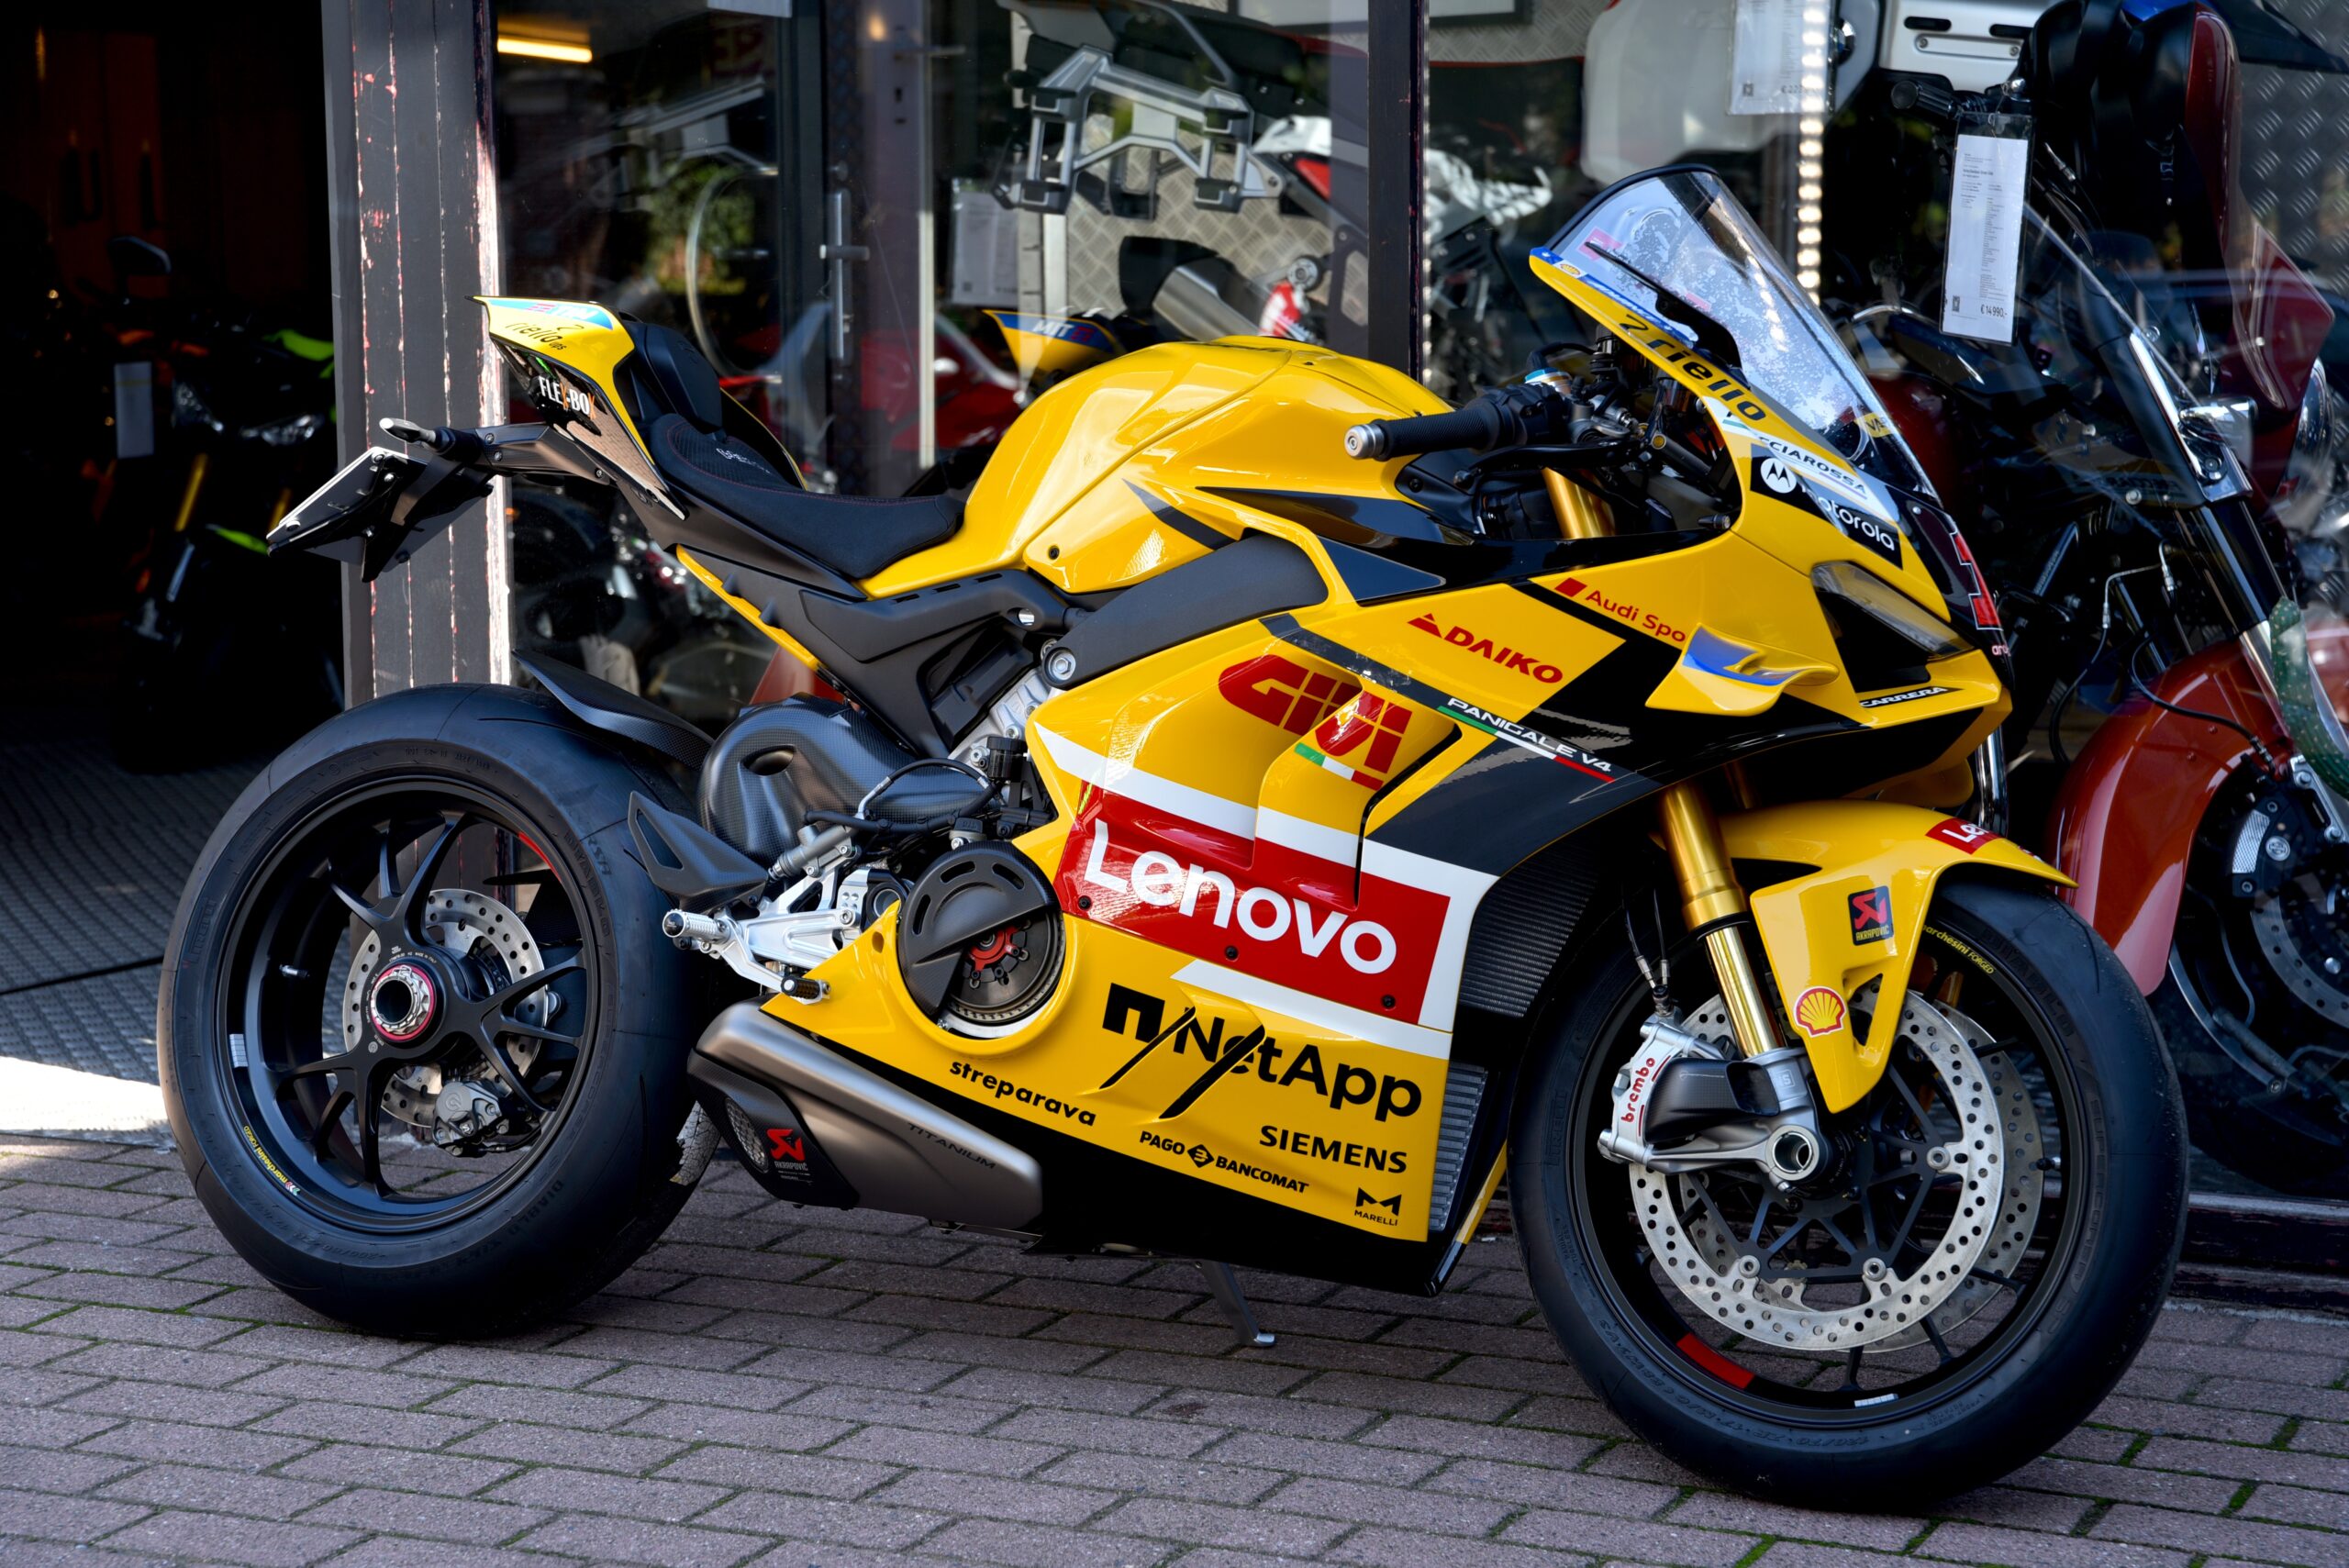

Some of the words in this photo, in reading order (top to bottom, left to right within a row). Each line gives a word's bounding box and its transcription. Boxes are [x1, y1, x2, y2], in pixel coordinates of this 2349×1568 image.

[539, 374, 596, 420] FLEX-BOX
[1647, 339, 1766, 421] riello
[1759, 435, 1867, 495] CIAROSSA
[1586, 590, 1640, 623] Audi
[1643, 614, 1687, 643] Spo
[1442, 625, 1564, 684] DAIKO
[1219, 652, 1414, 774] GIVI
[1859, 685, 1949, 708] CARRERA
[1447, 696, 1577, 758] PANIGALE
[1577, 751, 1613, 774] V4
[1082, 818, 1397, 974] Lenovo
[1967, 949, 1996, 974] FORGED
[949, 1059, 1097, 1128] streparava
[1173, 1006, 1424, 1123] NetApp
[1620, 1057, 1656, 1125] brembo
[254, 1146, 288, 1184] marchesini
[907, 1121, 996, 1170] TITANIUM
[1138, 1129, 1186, 1157] PAGO
[1215, 1154, 1309, 1195] BANCOMAT
[1259, 1124, 1408, 1175] SIEMENS
[1353, 1208, 1398, 1228] MARELLI
